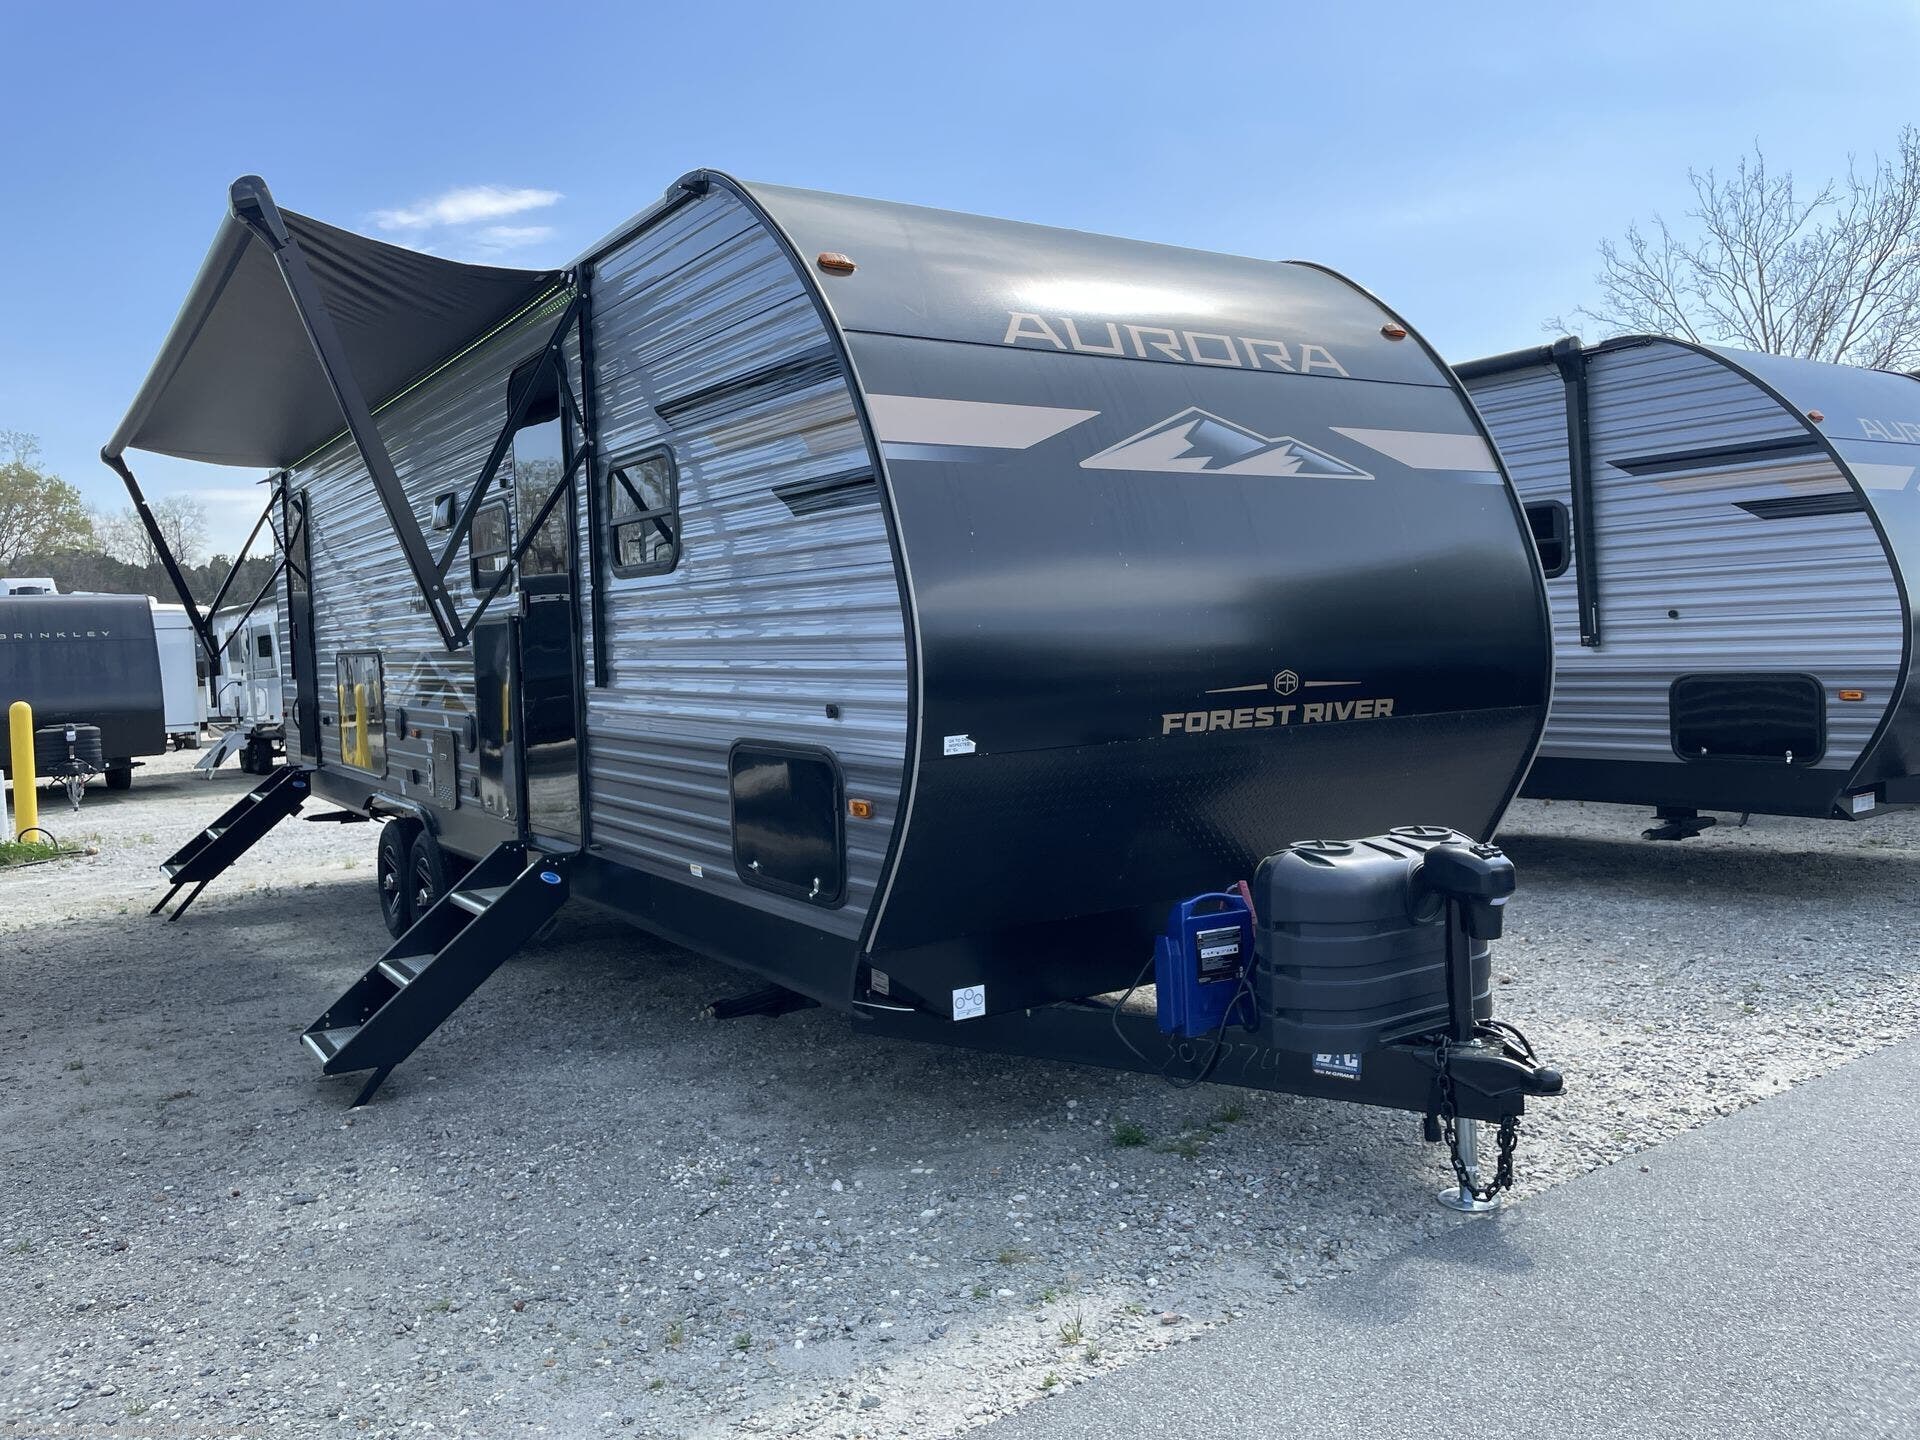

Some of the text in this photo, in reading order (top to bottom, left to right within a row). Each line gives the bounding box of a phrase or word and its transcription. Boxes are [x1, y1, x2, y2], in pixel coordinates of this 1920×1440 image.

[1004, 310, 1350, 377] AURORA
[1161, 698, 1394, 735] FOREST RIVER
